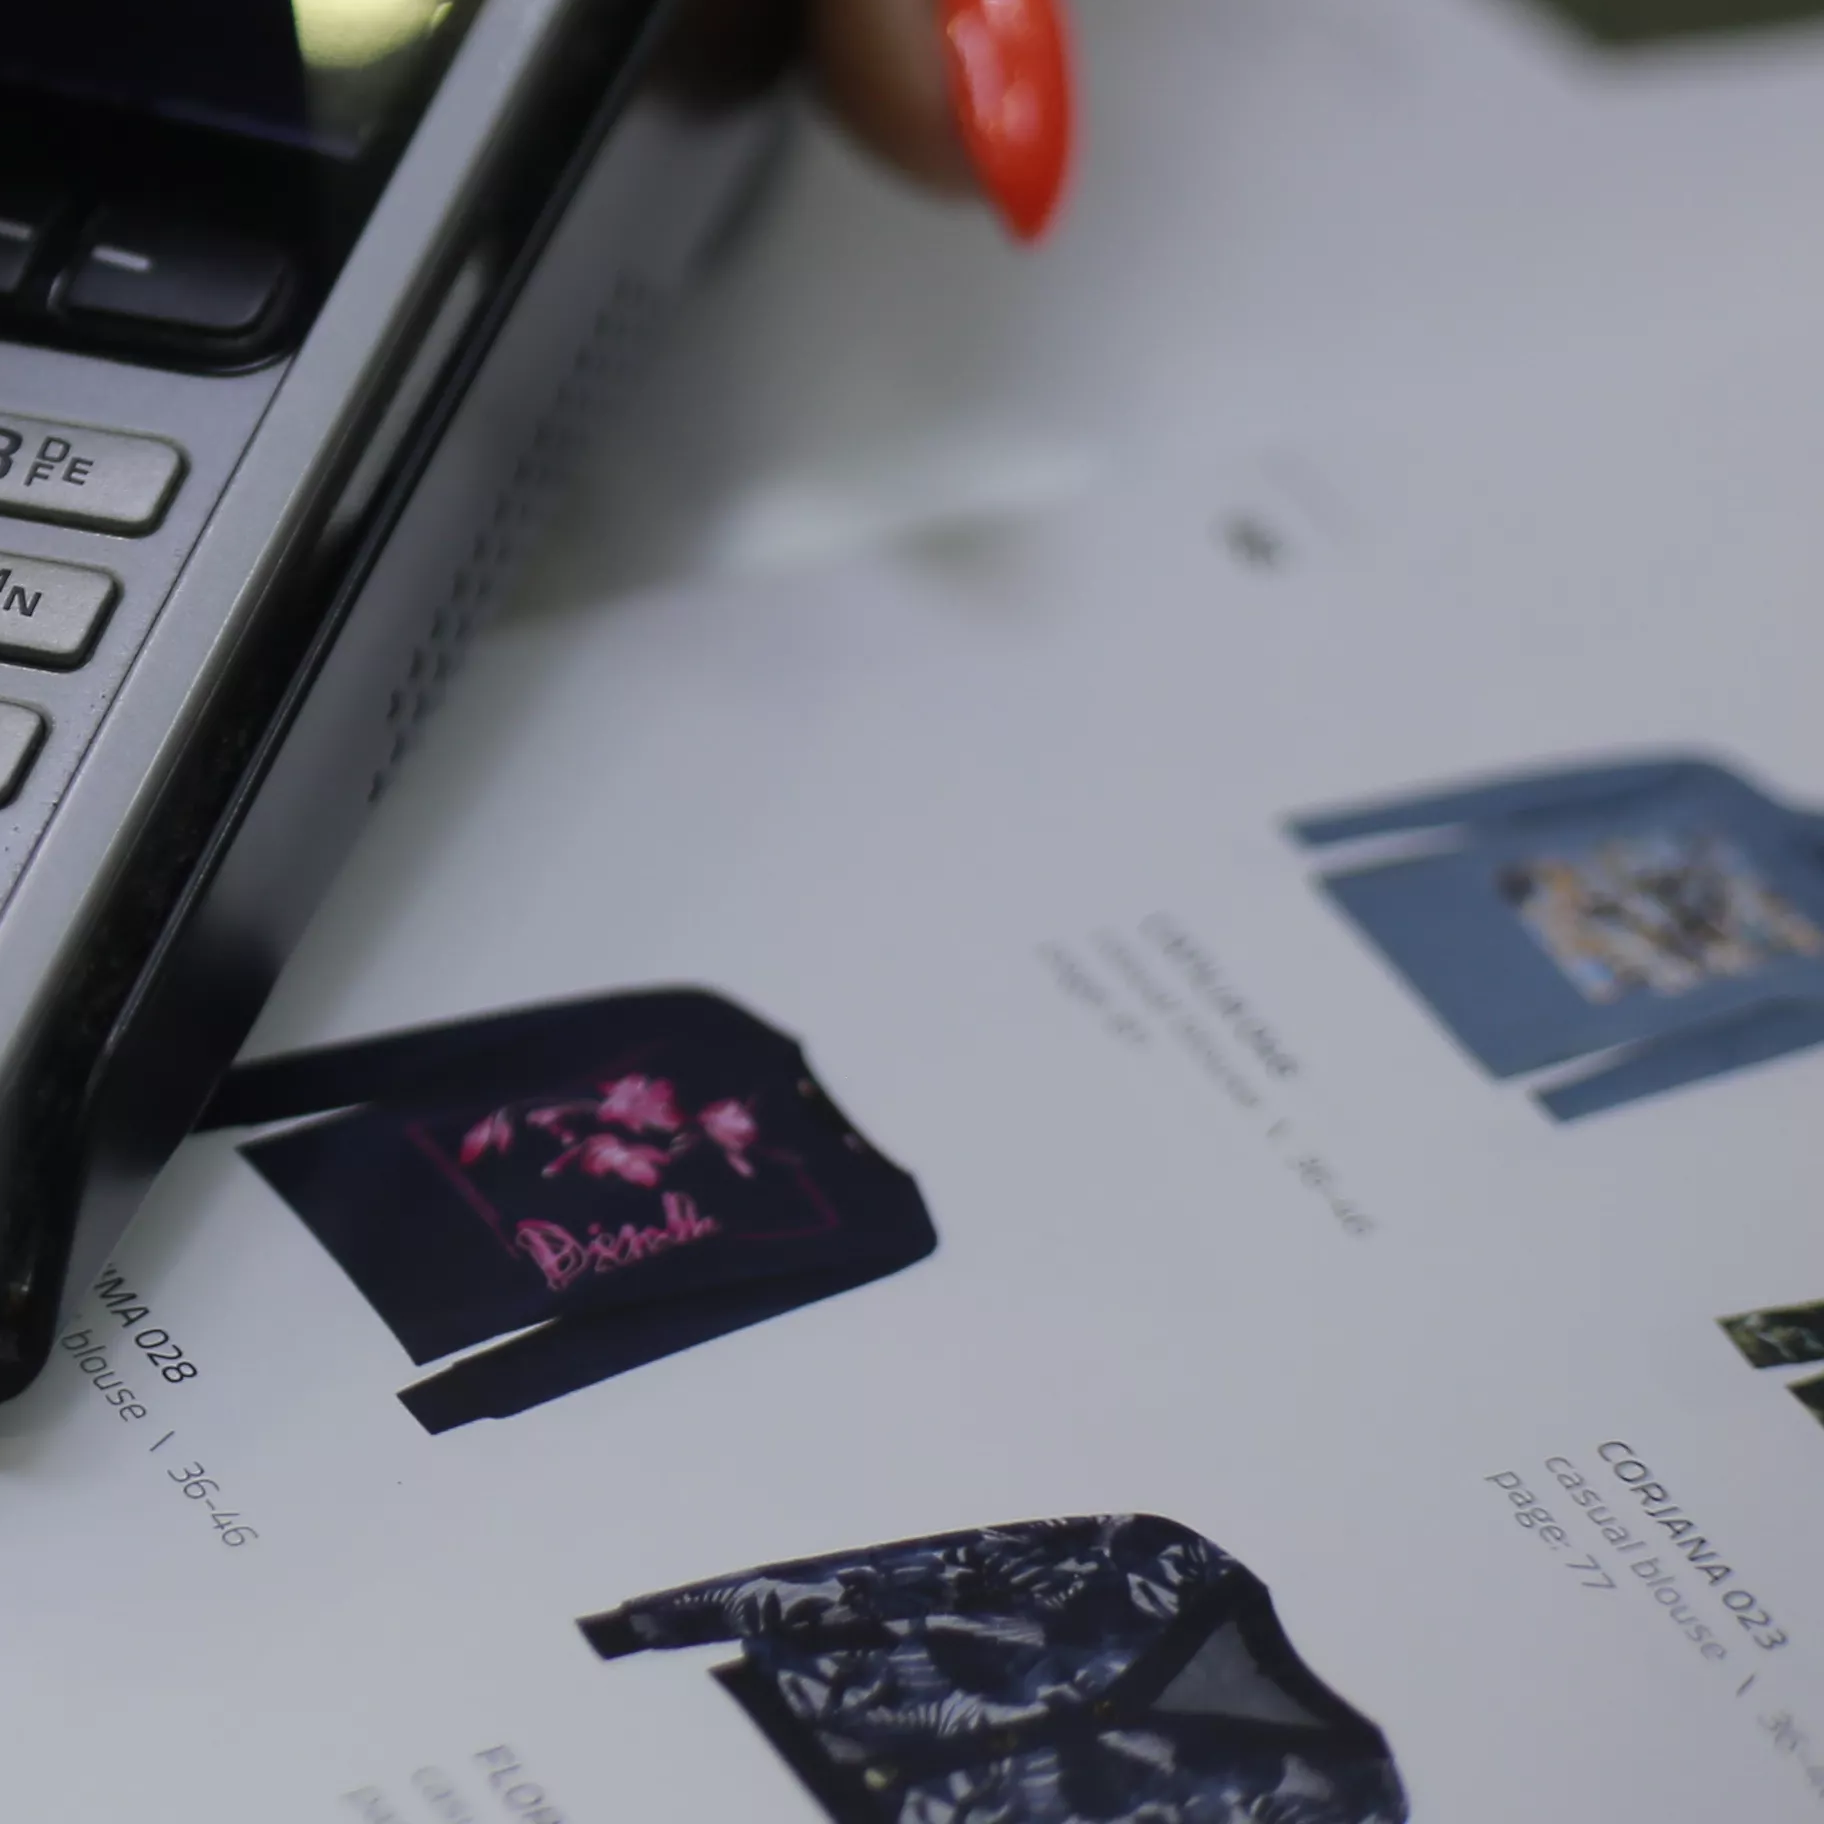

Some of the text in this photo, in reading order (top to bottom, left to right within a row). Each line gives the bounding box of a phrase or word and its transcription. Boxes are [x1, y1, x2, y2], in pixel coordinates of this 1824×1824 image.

[135, 1329, 198, 1383] 028
[61, 1329, 147, 1422] blouse
[167, 1461, 259, 1547] 36-46
[1484, 1471, 1618, 1590] page: 77
[1545, 1456, 1647, 1553] casual
[1631, 1556, 1728, 1661] blouse
[1721, 1590, 1790, 1651] 023
